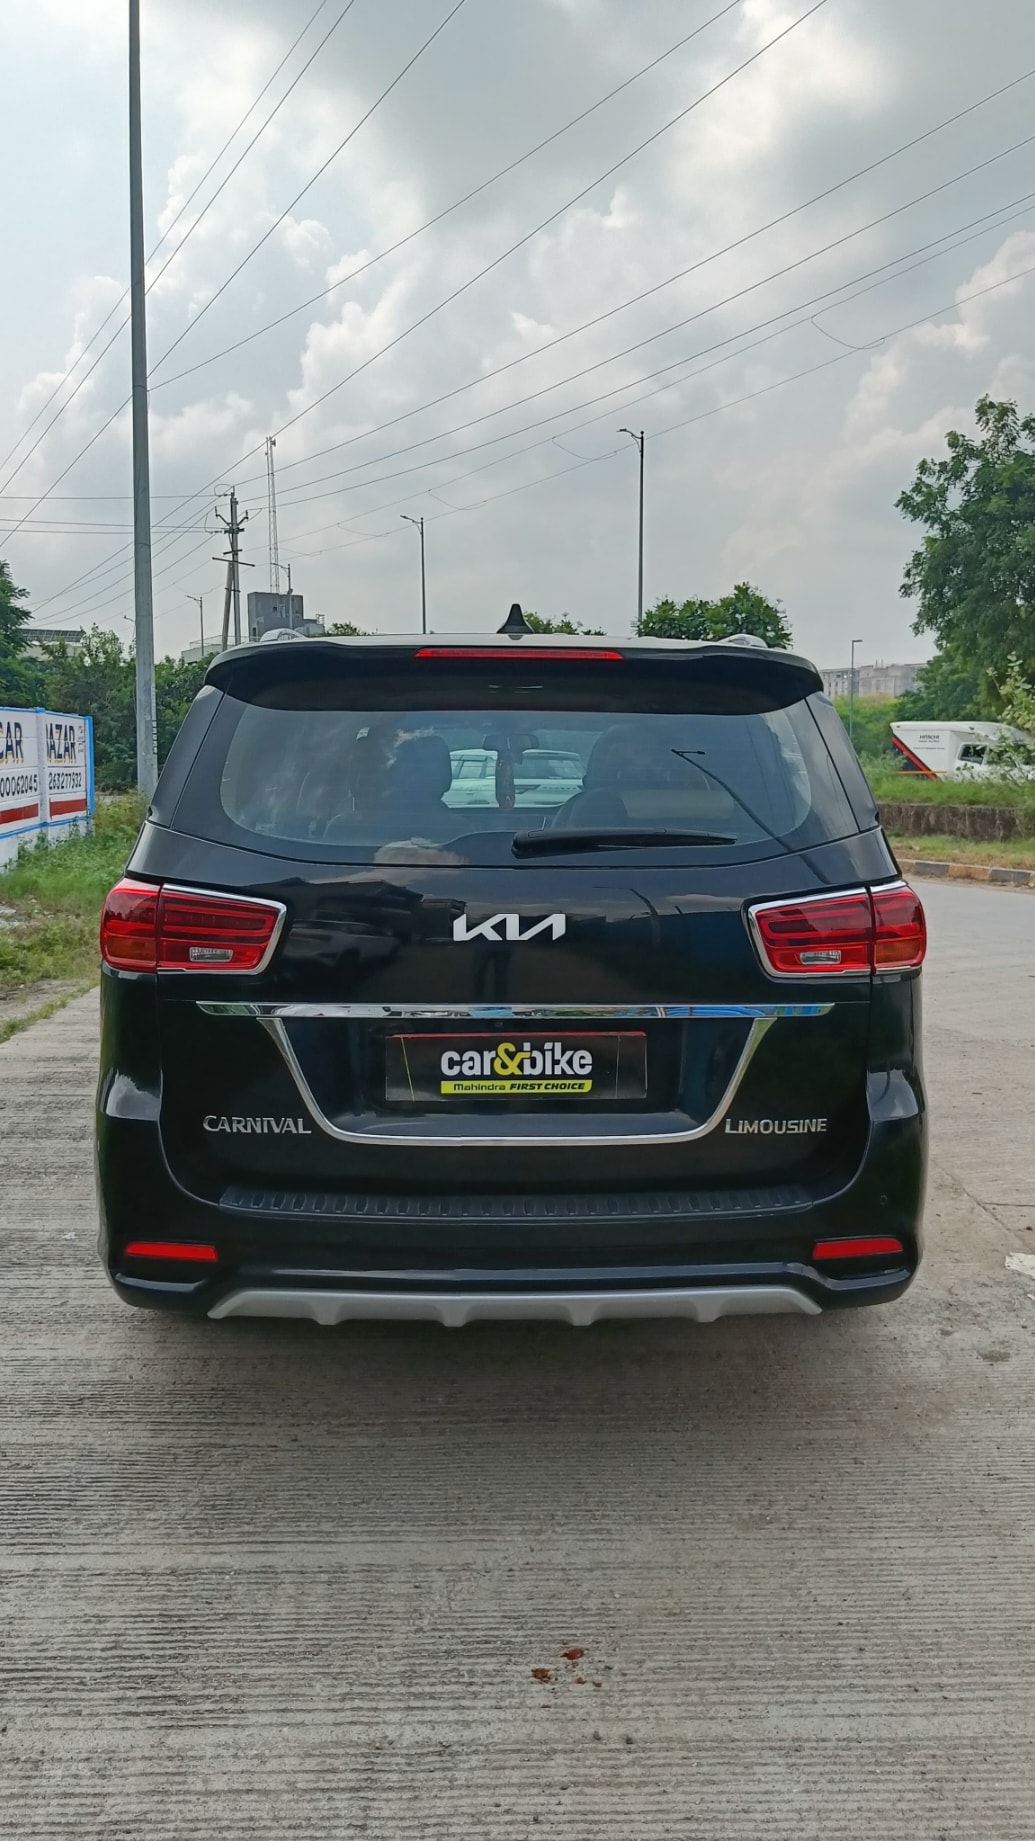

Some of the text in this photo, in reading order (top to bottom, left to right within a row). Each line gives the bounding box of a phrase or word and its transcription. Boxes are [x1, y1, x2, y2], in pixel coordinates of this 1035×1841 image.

[46, 723, 76, 762] AZAR
[453, 913, 566, 942] KIA
[441, 1042, 593, 1076] car&bike
[453, 1082, 586, 1091] Mahindra FIRST CHOICE
[202, 1115, 312, 1134] CARNIVAL
[725, 1118, 828, 1134] LIMOUSINE
